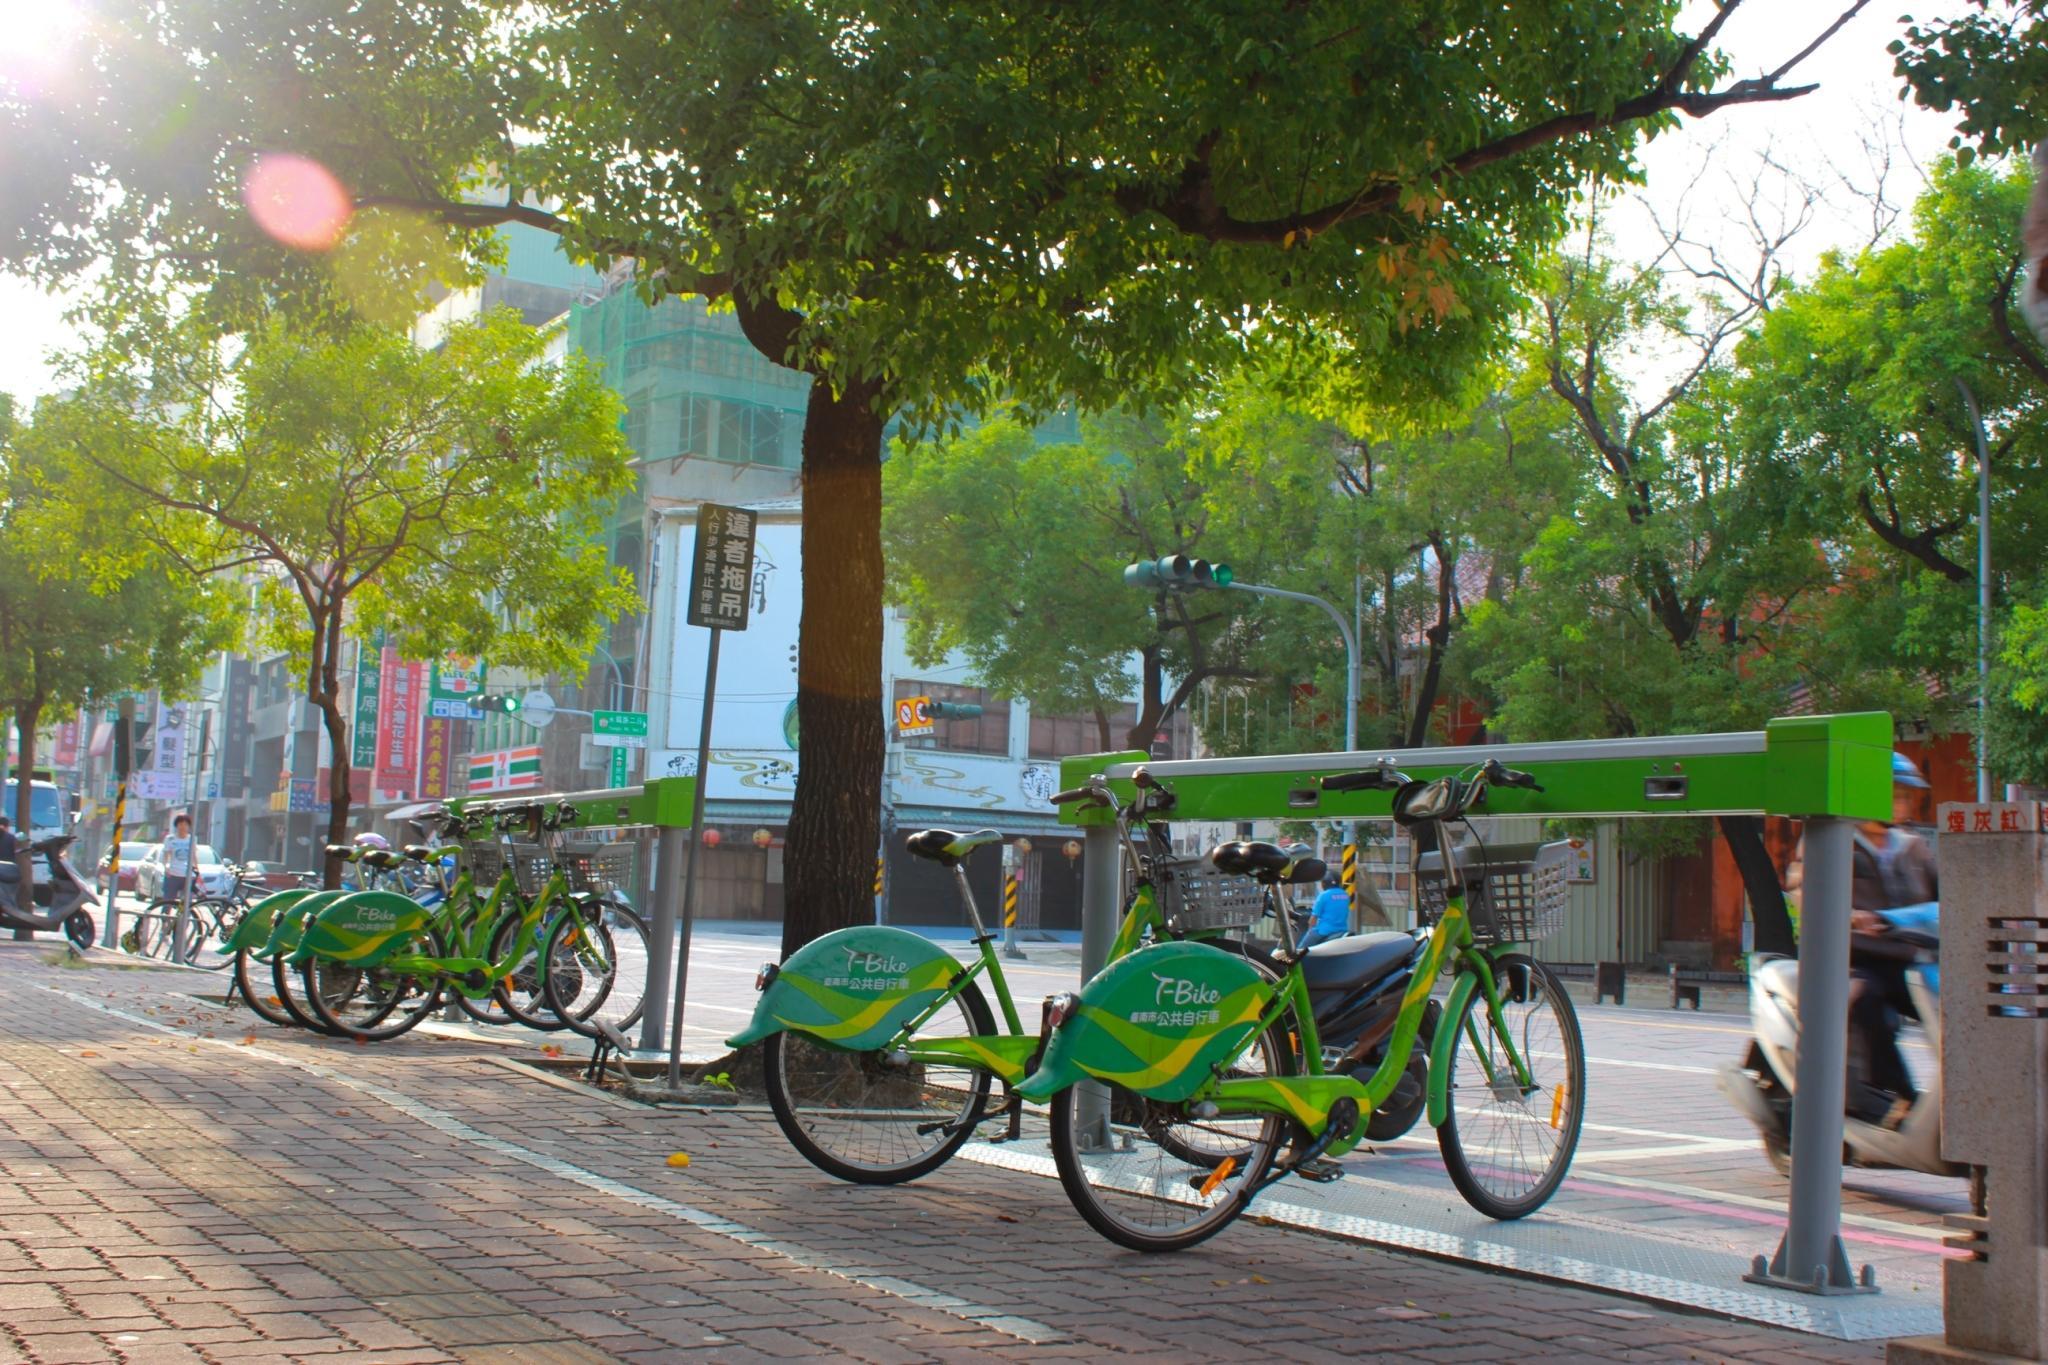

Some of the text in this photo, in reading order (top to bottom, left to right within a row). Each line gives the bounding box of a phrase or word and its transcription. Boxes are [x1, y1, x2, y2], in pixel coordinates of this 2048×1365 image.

[719, 511, 751, 617] 違者拖吊
[354, 904, 398, 920] T-Bike
[842, 946, 909, 973] T-Bike
[1151, 971, 1221, 1006] T-Bike
